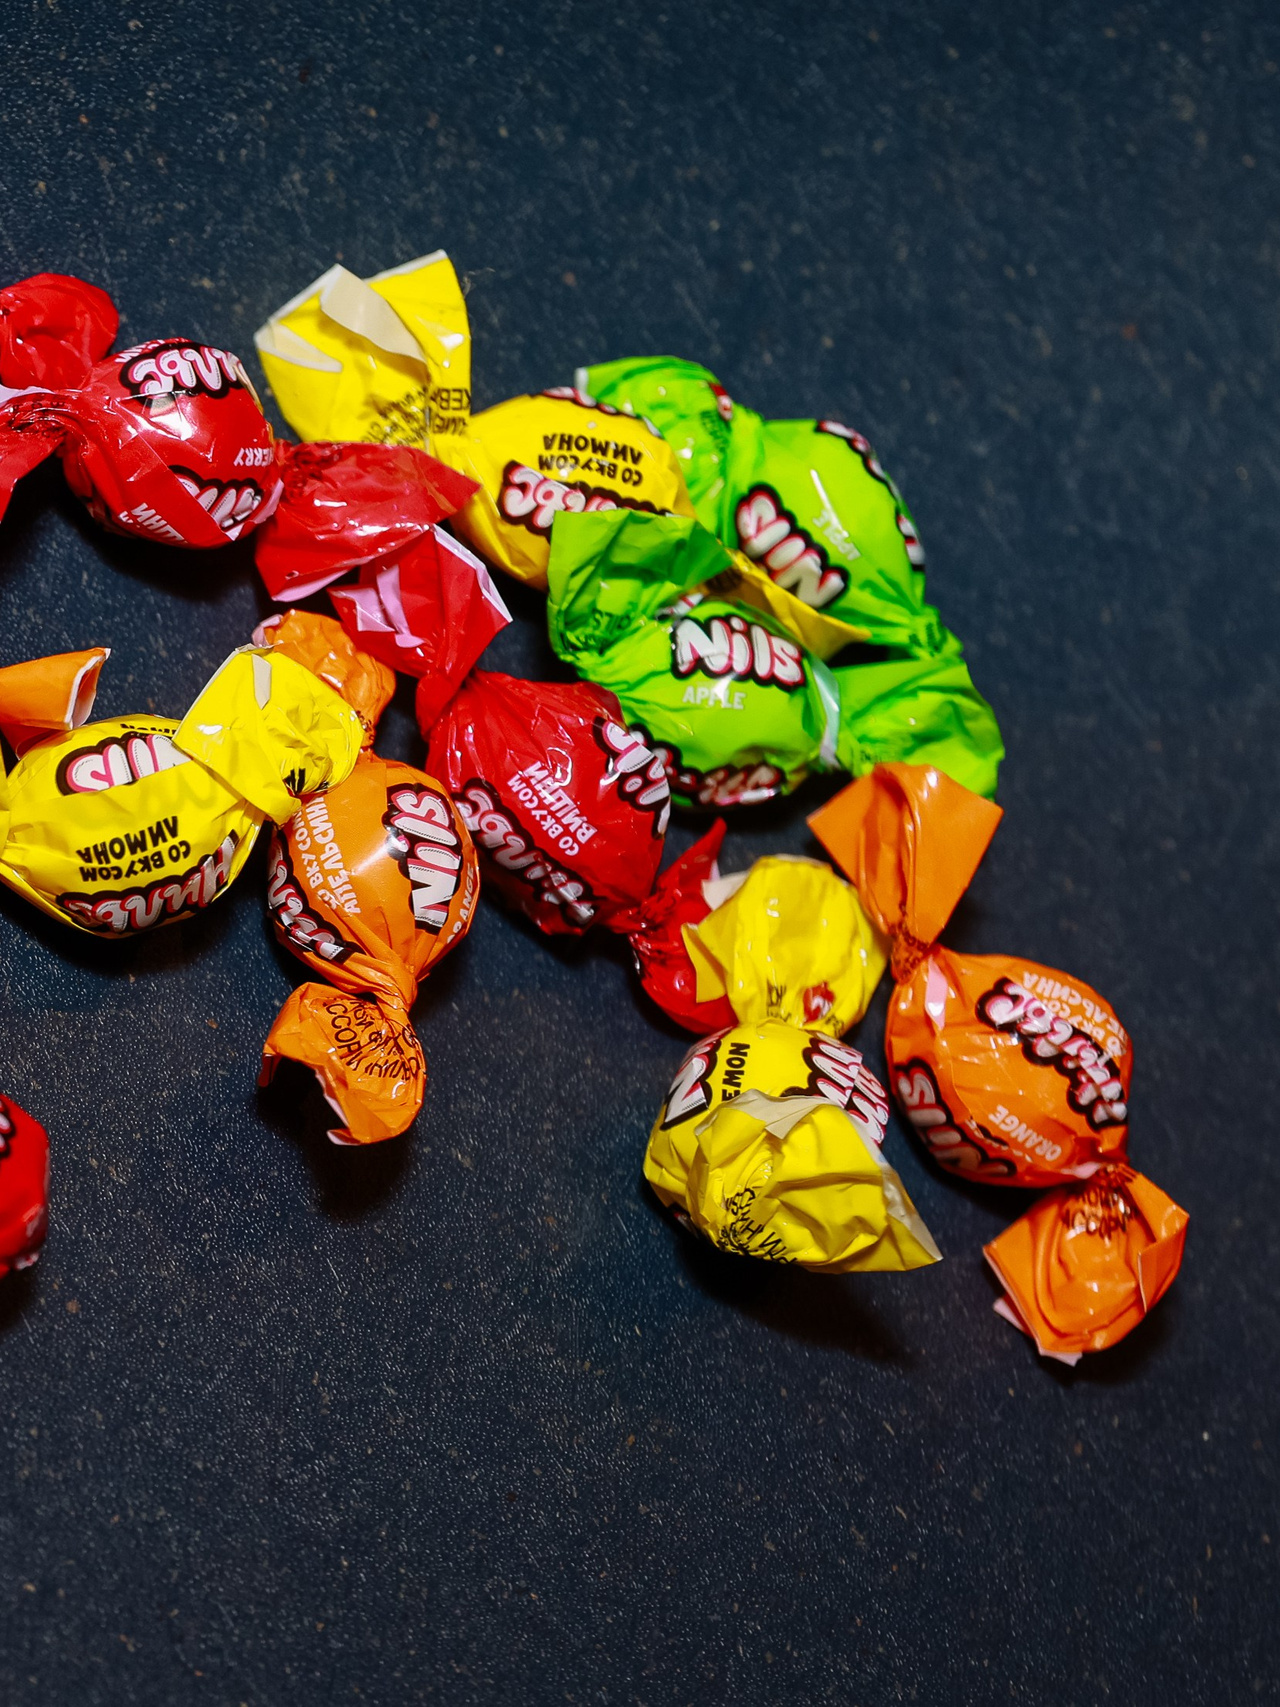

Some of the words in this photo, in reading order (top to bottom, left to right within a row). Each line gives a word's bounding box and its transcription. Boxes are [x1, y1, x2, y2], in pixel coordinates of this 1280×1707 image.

[542, 434, 643, 463] ЛИМОНА
[619, 465, 643, 485] СО
[737, 492, 846, 608] Nils
[673, 616, 805, 687] Nils
[683, 686, 746, 710] APPLE
[507, 773, 563, 839] ВКУСОМ
[77, 816, 178, 864] ЛИМОНА
[168, 840, 190, 862] СО
[305, 796, 361, 914] АПЕЛЬСИН
[392, 789, 460, 927] Nils
[556, 837, 579, 856] СО
[80, 853, 165, 881] ВКУСОМ
[722, 1042, 751, 1101] EMON
[989, 1104, 1062, 1162] ORANGE
